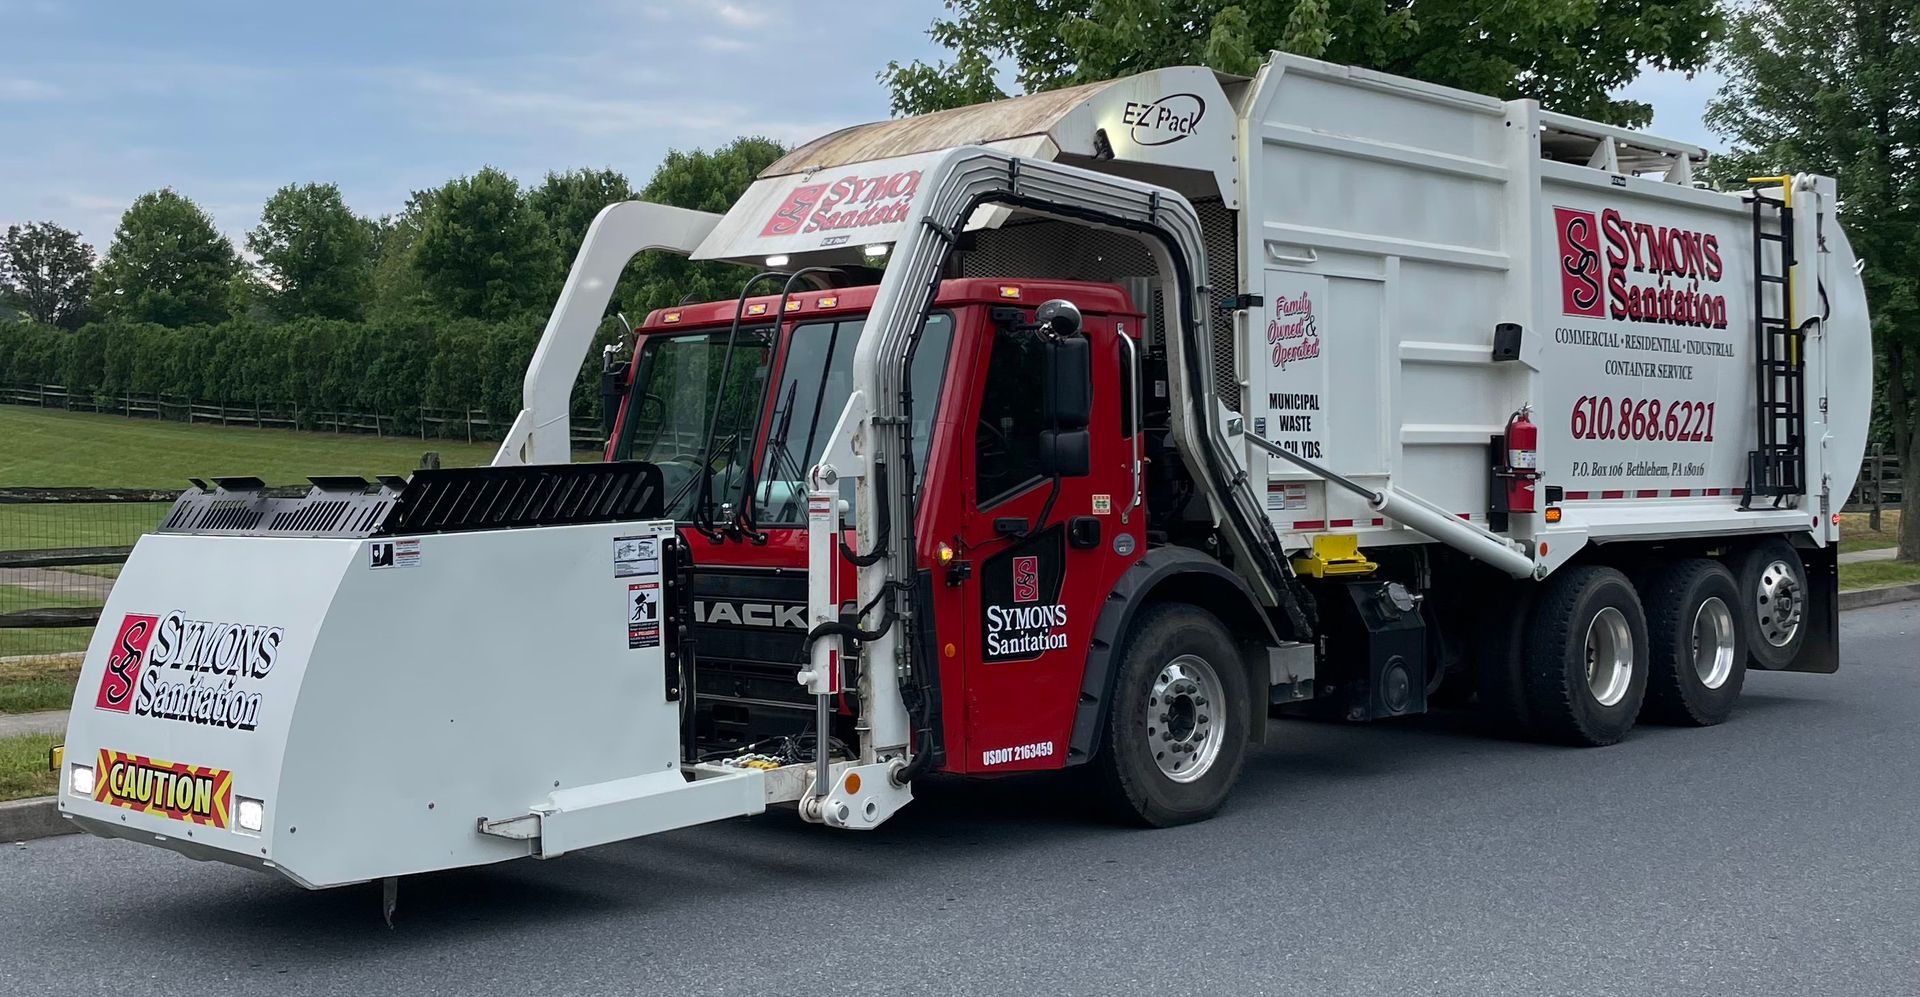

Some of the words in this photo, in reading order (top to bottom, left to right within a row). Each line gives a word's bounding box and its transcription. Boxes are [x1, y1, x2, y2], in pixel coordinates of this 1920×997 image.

[1155, 107, 1198, 135] Pack
[821, 170, 924, 213] SYMO
[802, 193, 911, 234] Sanitati
[1601, 208, 1723, 282] SYMONS
[1276, 291, 1312, 321] Family
[1608, 268, 1728, 330] Sanitation
[1267, 317, 1305, 345] Owned
[1305, 315, 1318, 337] &
[1555, 328, 1619, 348] COMMERCIAL
[1624, 335, 1682, 353] RESIDENTIAL
[1686, 340, 1735, 357] INDUSTRIAL
[1272, 338, 1321, 371] Operated
[1605, 360, 1656, 378] CONTAINER
[1657, 364, 1693, 380] SERVICE
[1269, 393, 1320, 410] MUNICIPAL
[1279, 415, 1312, 432] WASTE
[1571, 395, 1715, 442] 610.868.6221
[1301, 440, 1323, 459] YDS.
[1572, 462, 1590, 477] P.O.
[1591, 462, 1607, 477] Box
[1608, 462, 1623, 477] 106
[1626, 461, 1670, 478] Bethlehem,
[1671, 462, 1682, 477] PA
[1683, 462, 1705, 477] 18016
[987, 604, 1067, 632] SYMONS
[151, 609, 284, 679] SYMONS
[987, 628, 1068, 656] Sanitation
[136, 665, 263, 731] Sanitation
[983, 747, 1013, 766] USDOT
[1014, 741, 1053, 761] 2163459
[108, 759, 215, 817] CAUTION
